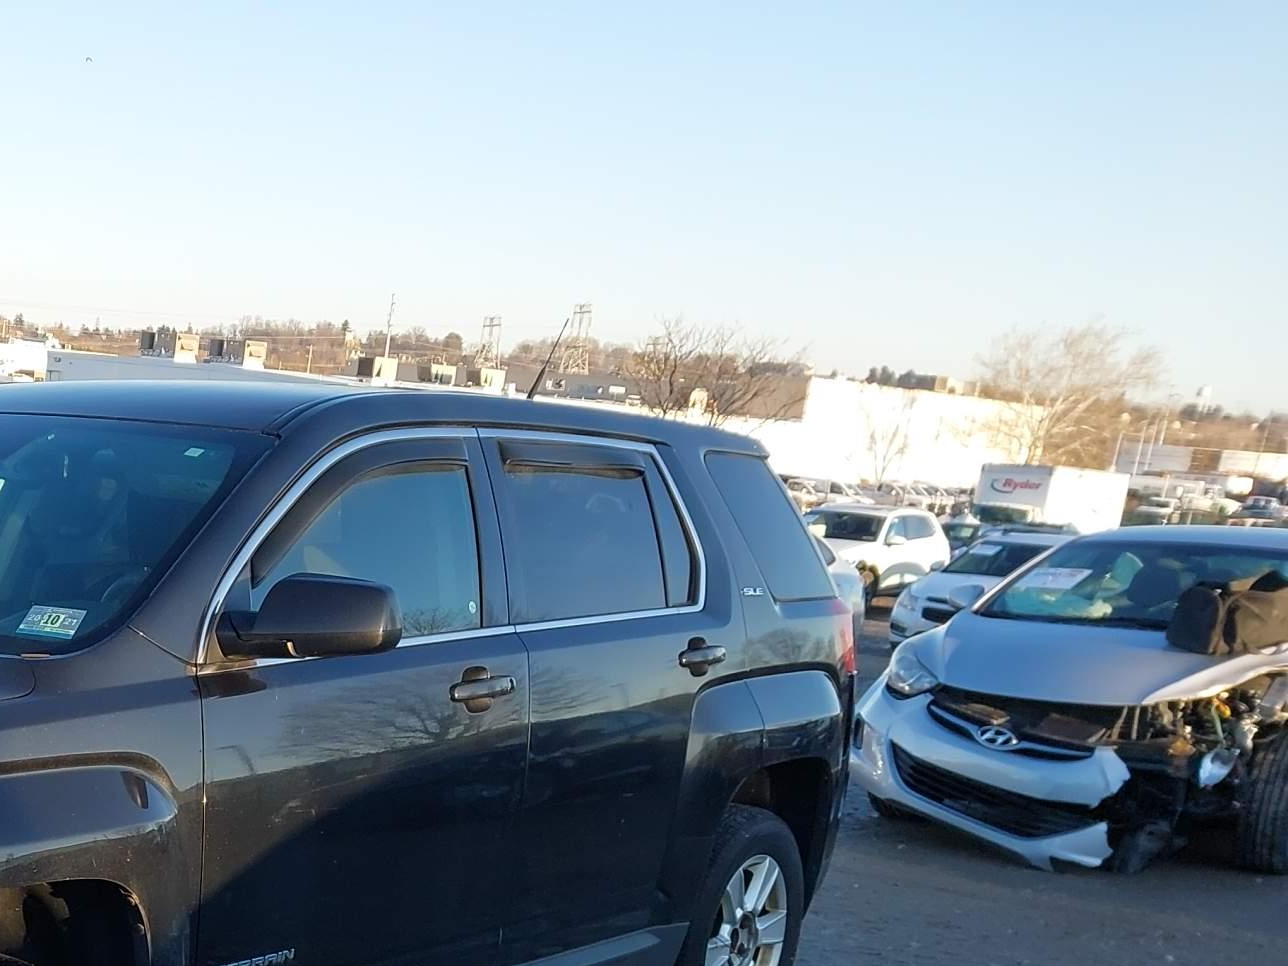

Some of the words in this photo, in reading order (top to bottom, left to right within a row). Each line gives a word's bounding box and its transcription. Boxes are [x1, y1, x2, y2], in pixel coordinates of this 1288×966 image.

[1001, 478, 1043, 491] Ryder
[743, 587, 764, 596] SLE
[43, 614, 61, 626] 10
